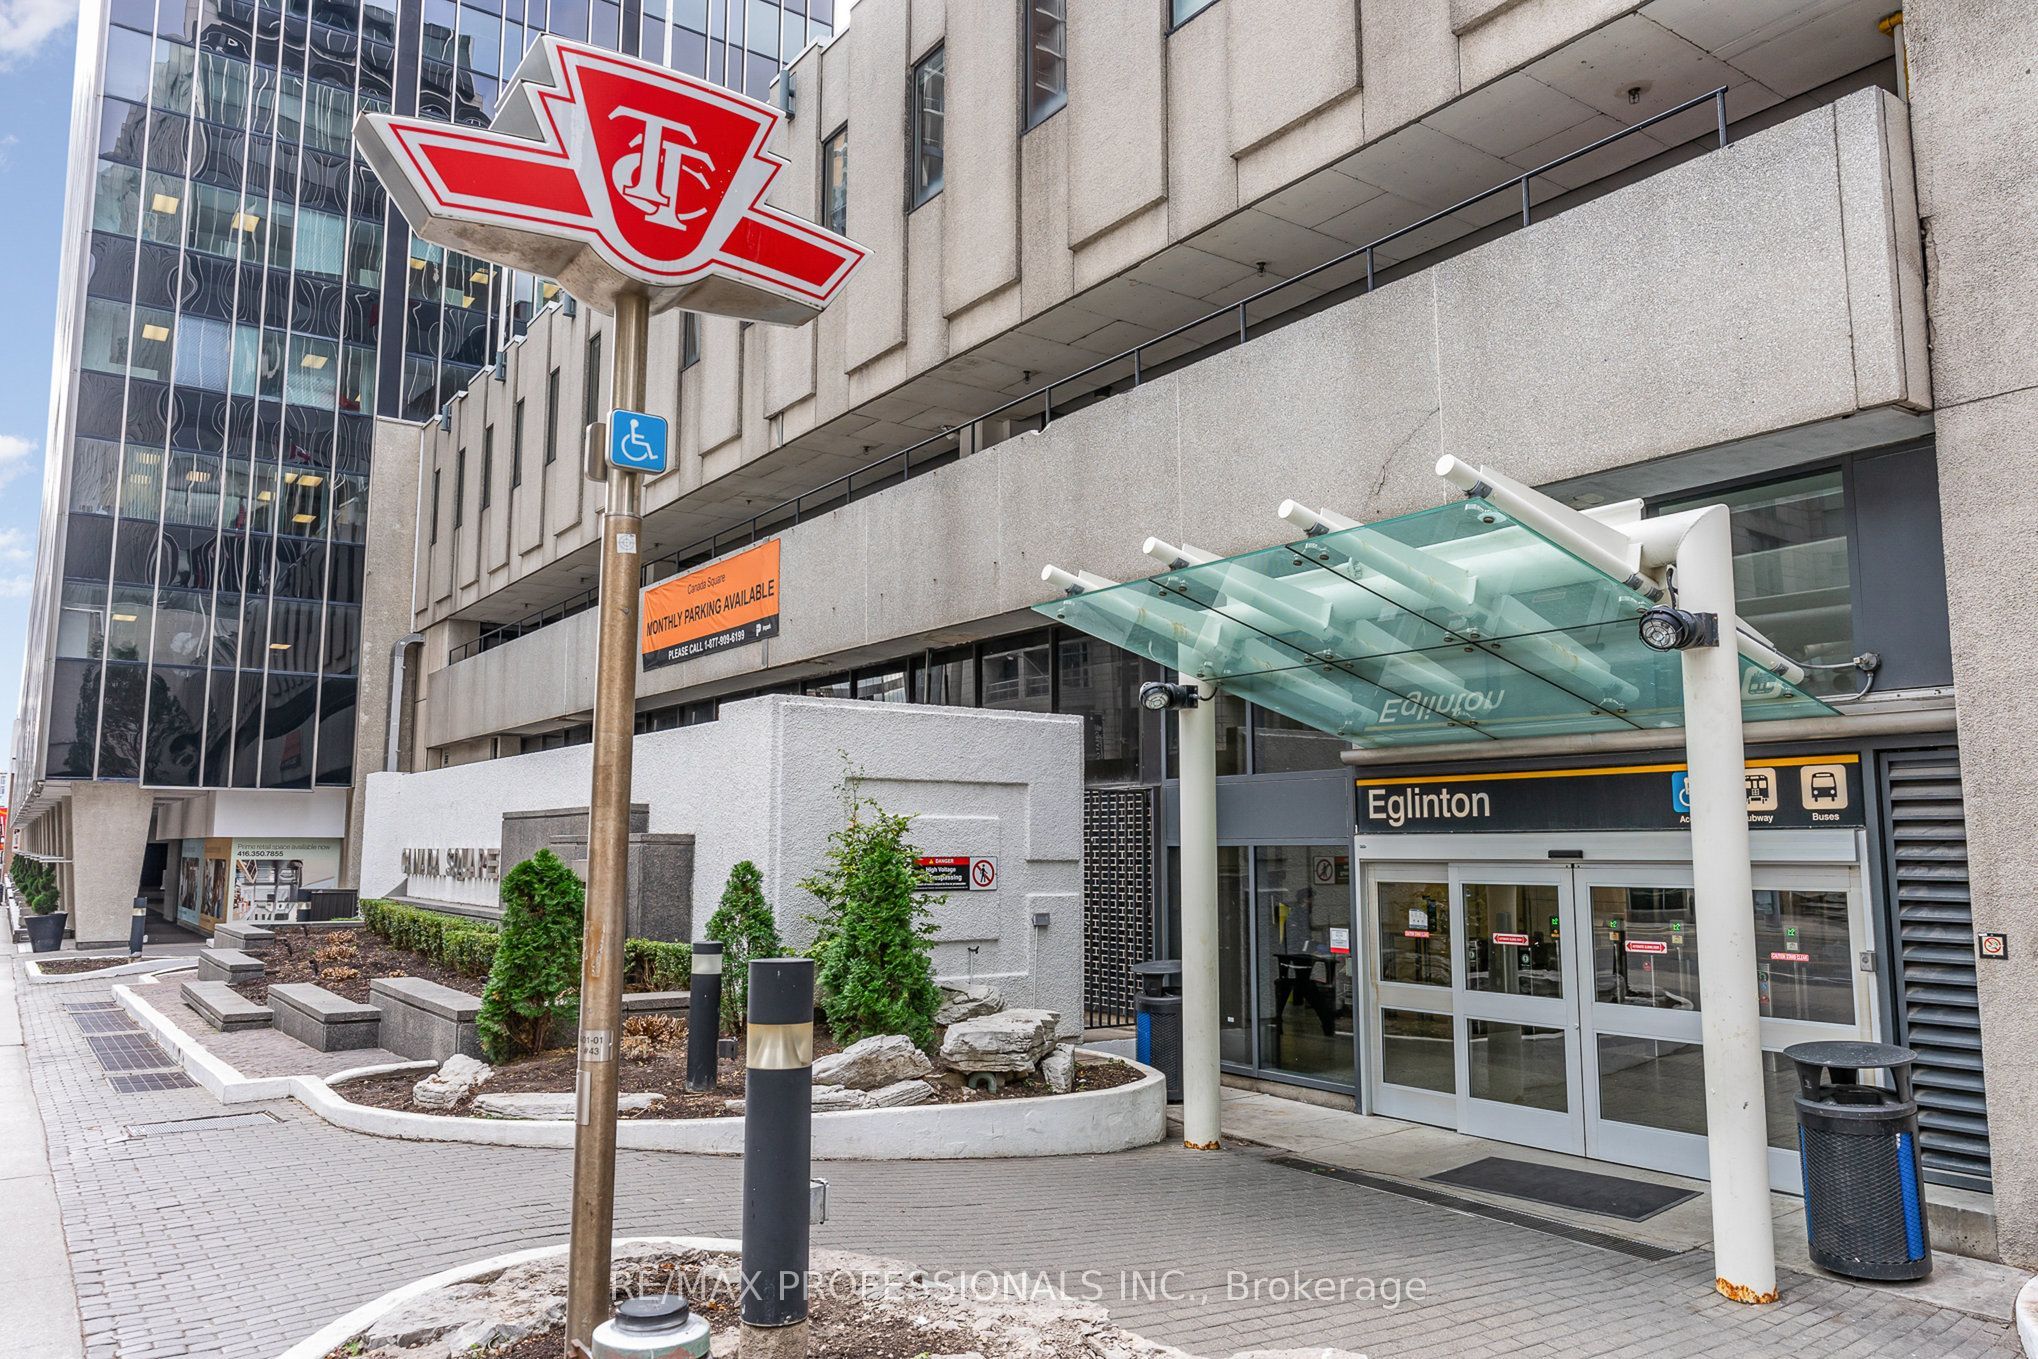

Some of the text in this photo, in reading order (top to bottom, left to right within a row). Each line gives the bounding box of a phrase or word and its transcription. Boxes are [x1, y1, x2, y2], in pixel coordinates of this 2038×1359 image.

[687, 573, 726, 595] Canada Square
[646, 579, 775, 637] MONTHLY PARKING AVAILABLE
[668, 629, 745, 660] PLEASE CALL 1-877-909-6199
[1368, 787, 1490, 827] Eglinton
[1812, 812, 1840, 821] Buses
[1748, 814, 1773, 824] ubway
[937, 866, 956, 874] Voltage
